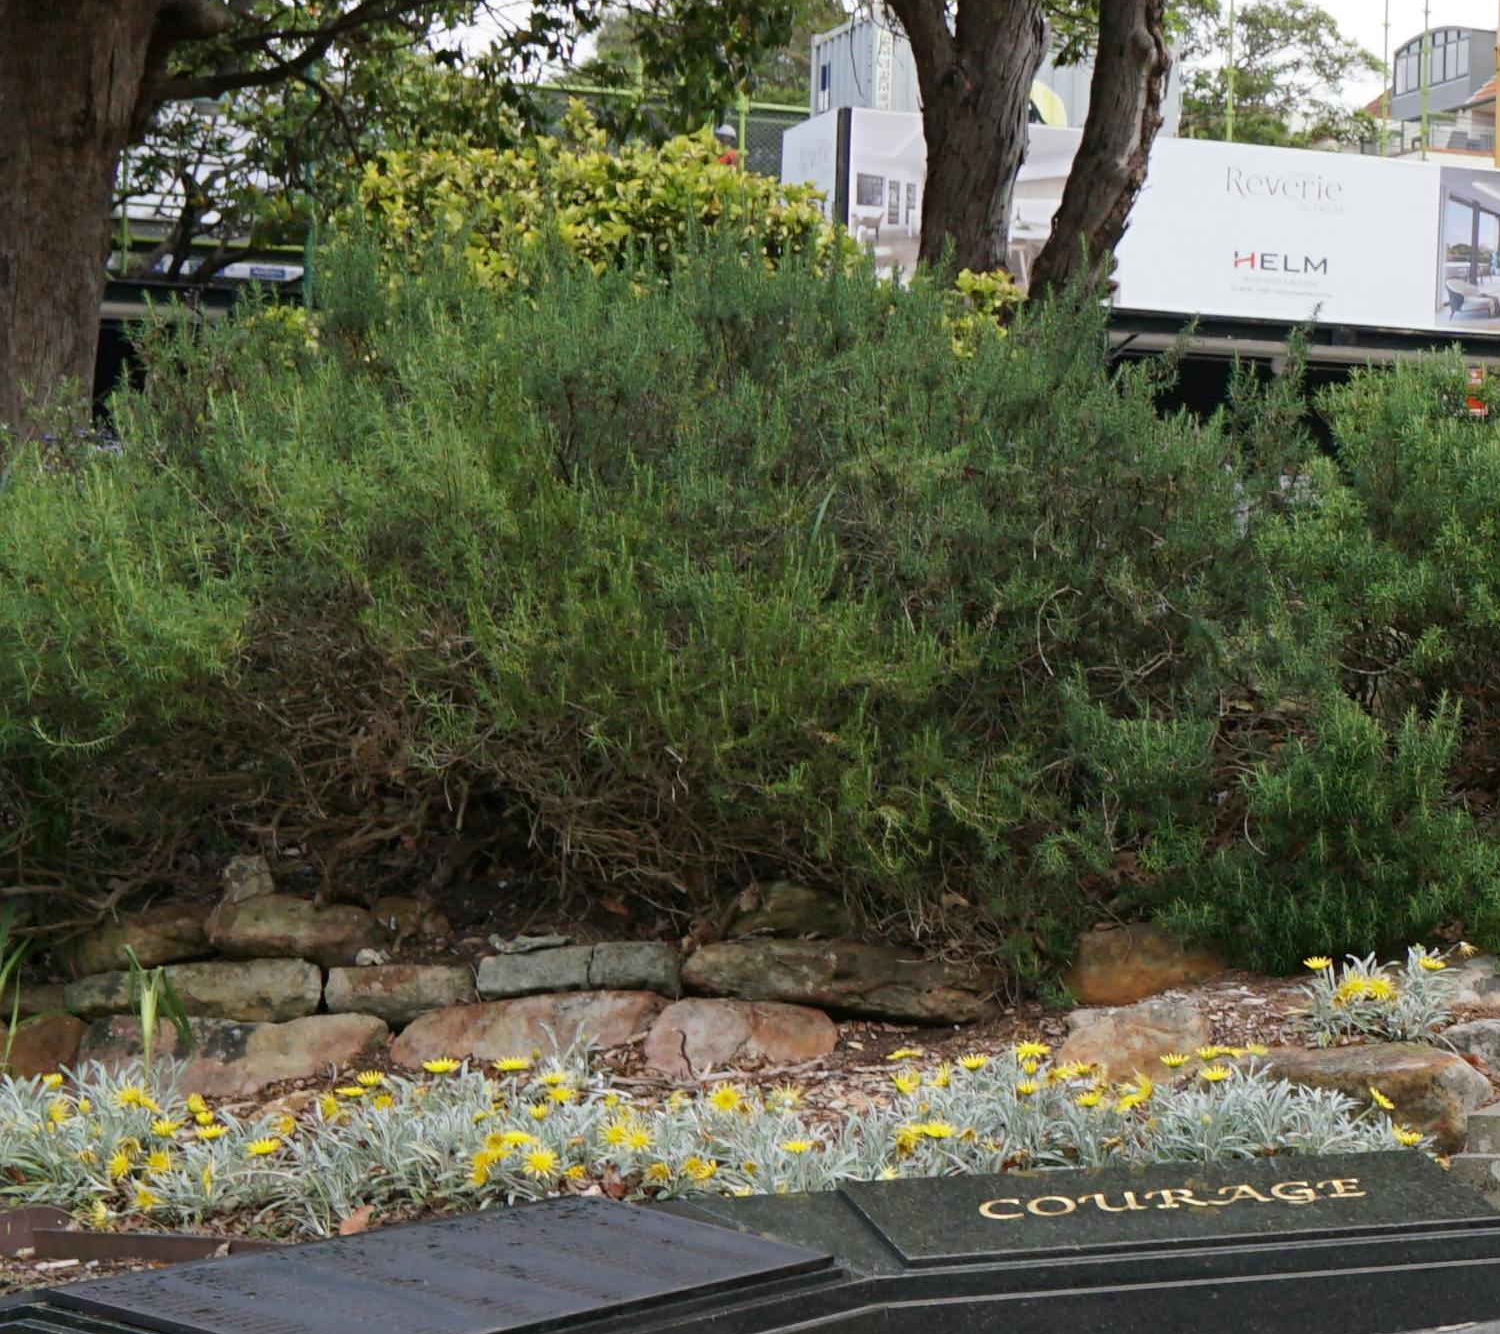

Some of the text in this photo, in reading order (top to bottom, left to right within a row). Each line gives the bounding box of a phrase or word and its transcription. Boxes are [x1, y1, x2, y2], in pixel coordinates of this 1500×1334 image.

[1226, 166, 1343, 201] Reverie
[1234, 250, 1328, 275] HELM
[978, 1177, 1368, 1221] COURAGE
